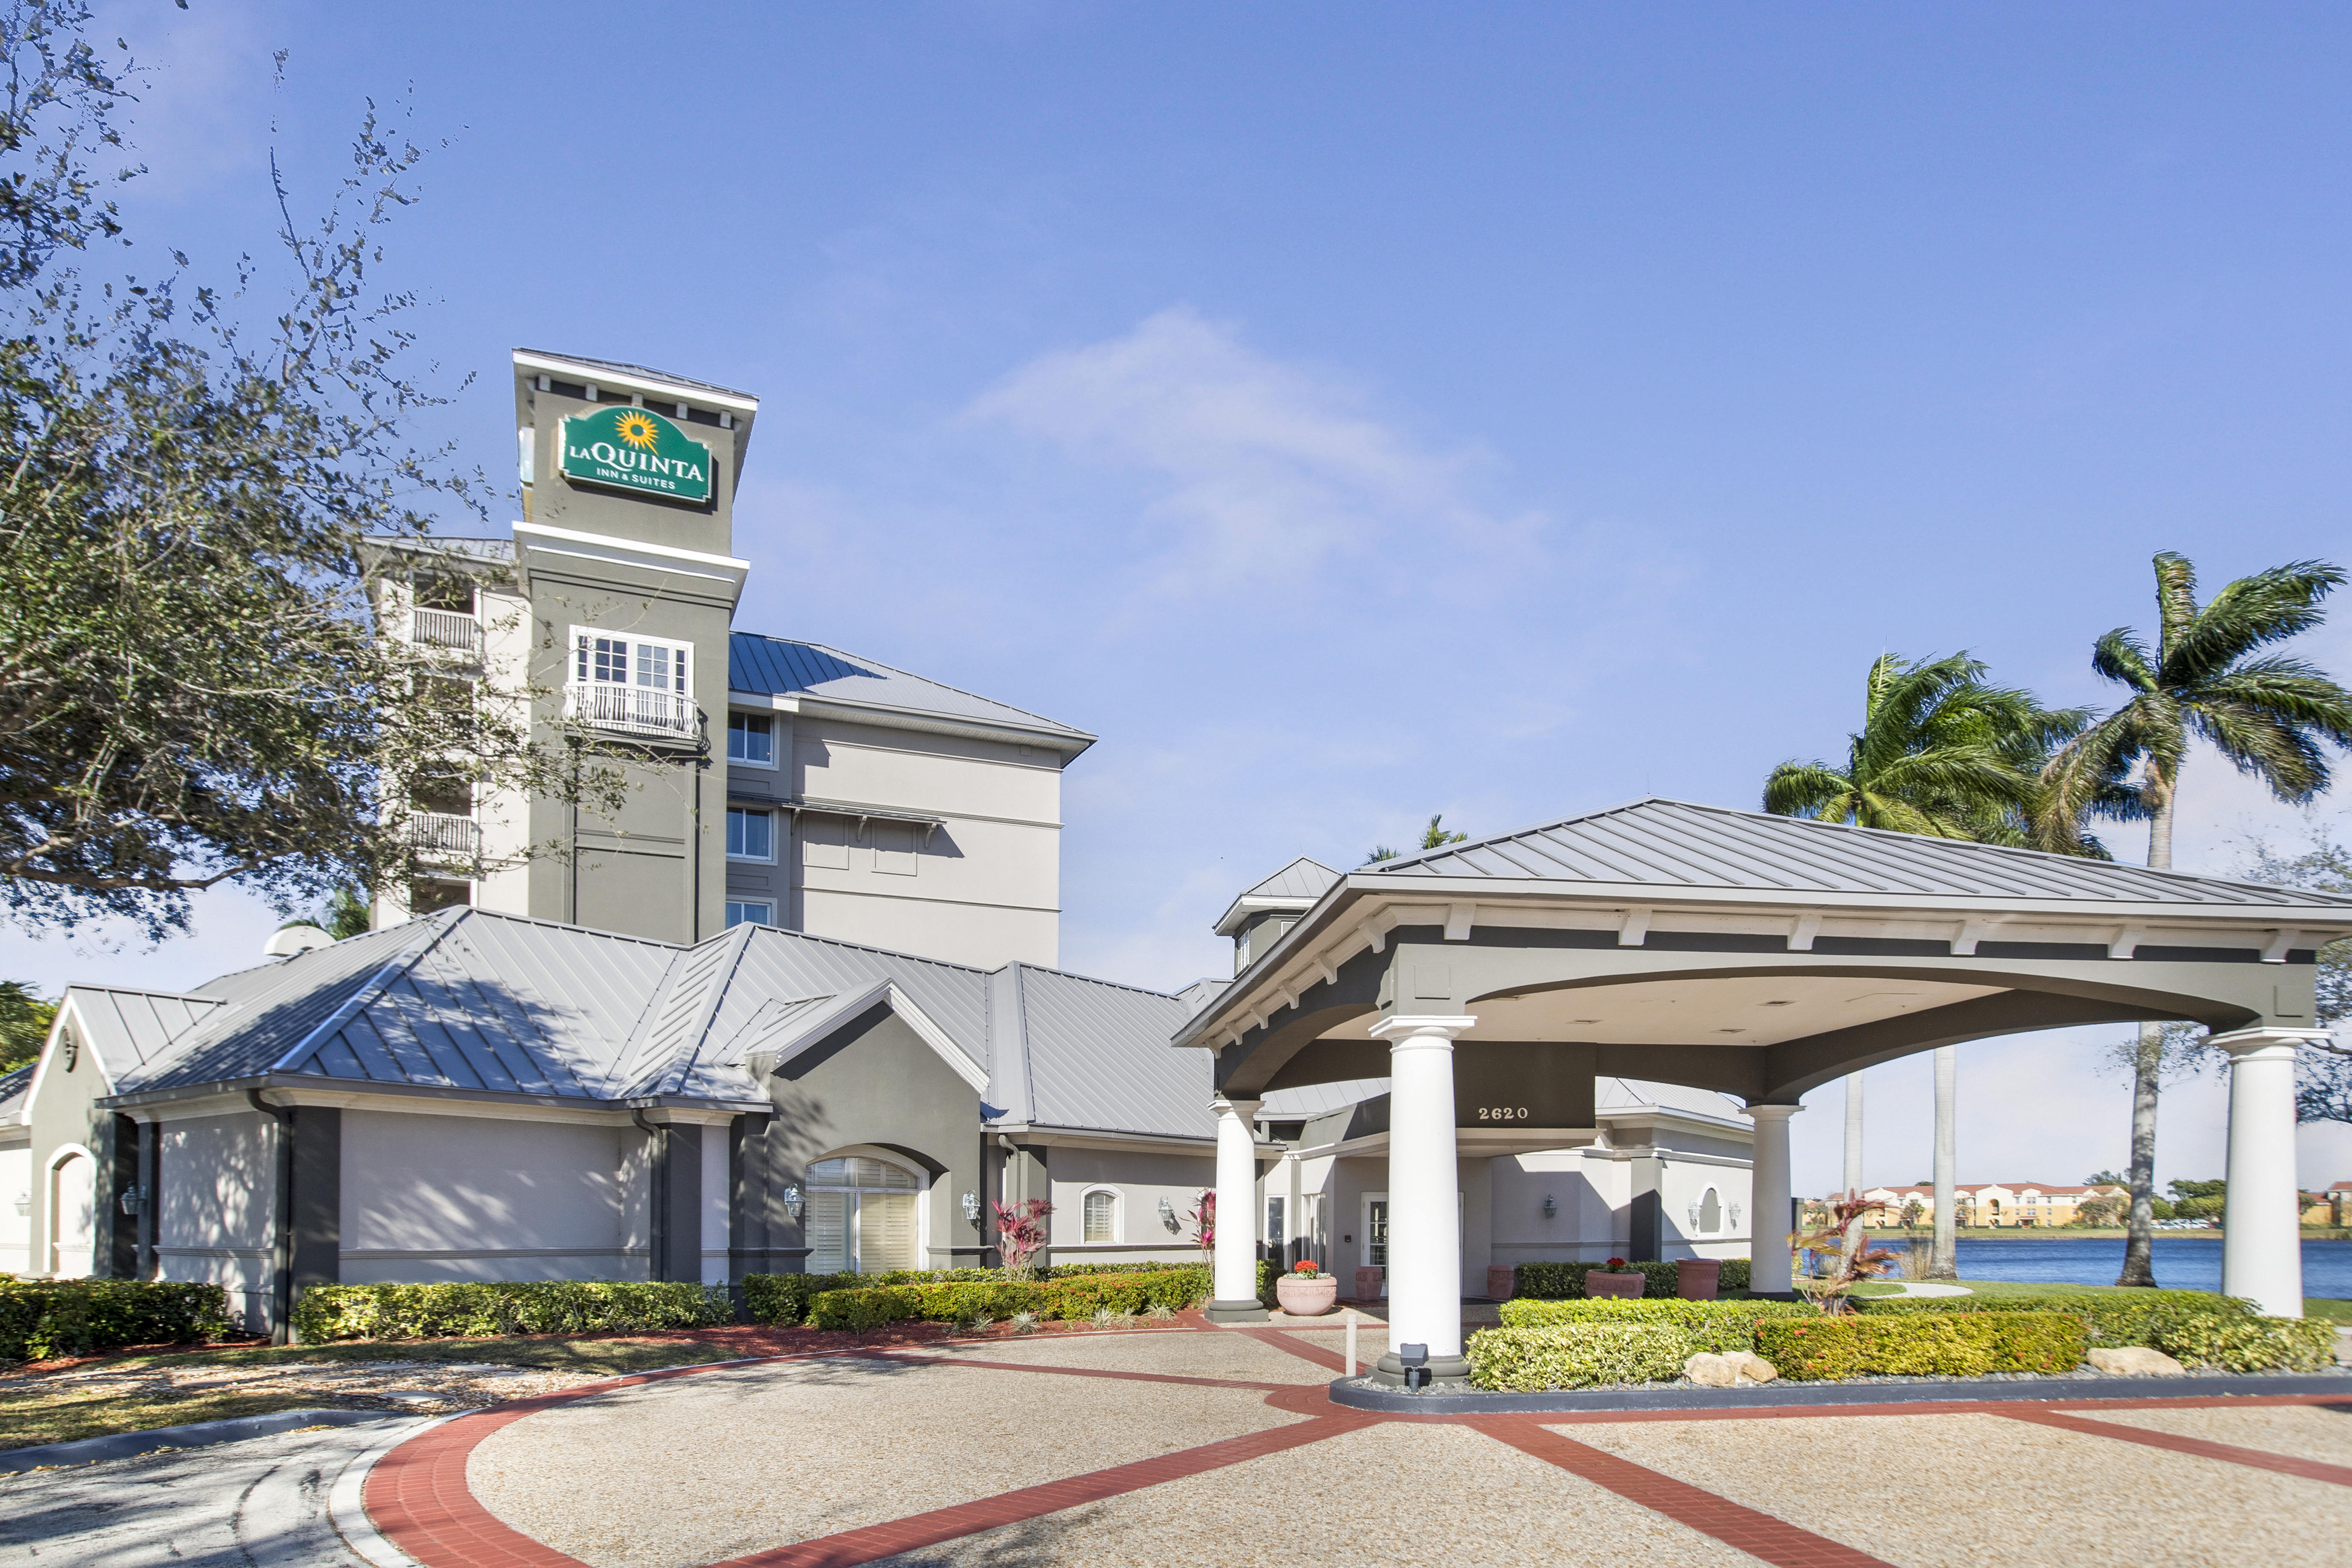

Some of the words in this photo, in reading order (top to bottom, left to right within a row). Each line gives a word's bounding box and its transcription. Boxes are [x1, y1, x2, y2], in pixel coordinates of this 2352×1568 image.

[570, 445, 591, 460] LA
[591, 442, 704, 482] QUINTA
[596, 467, 619, 479] INN
[621, 473, 629, 481] &
[631, 474, 676, 490] SUITES
[1478, 1107, 1528, 1120] 2620
